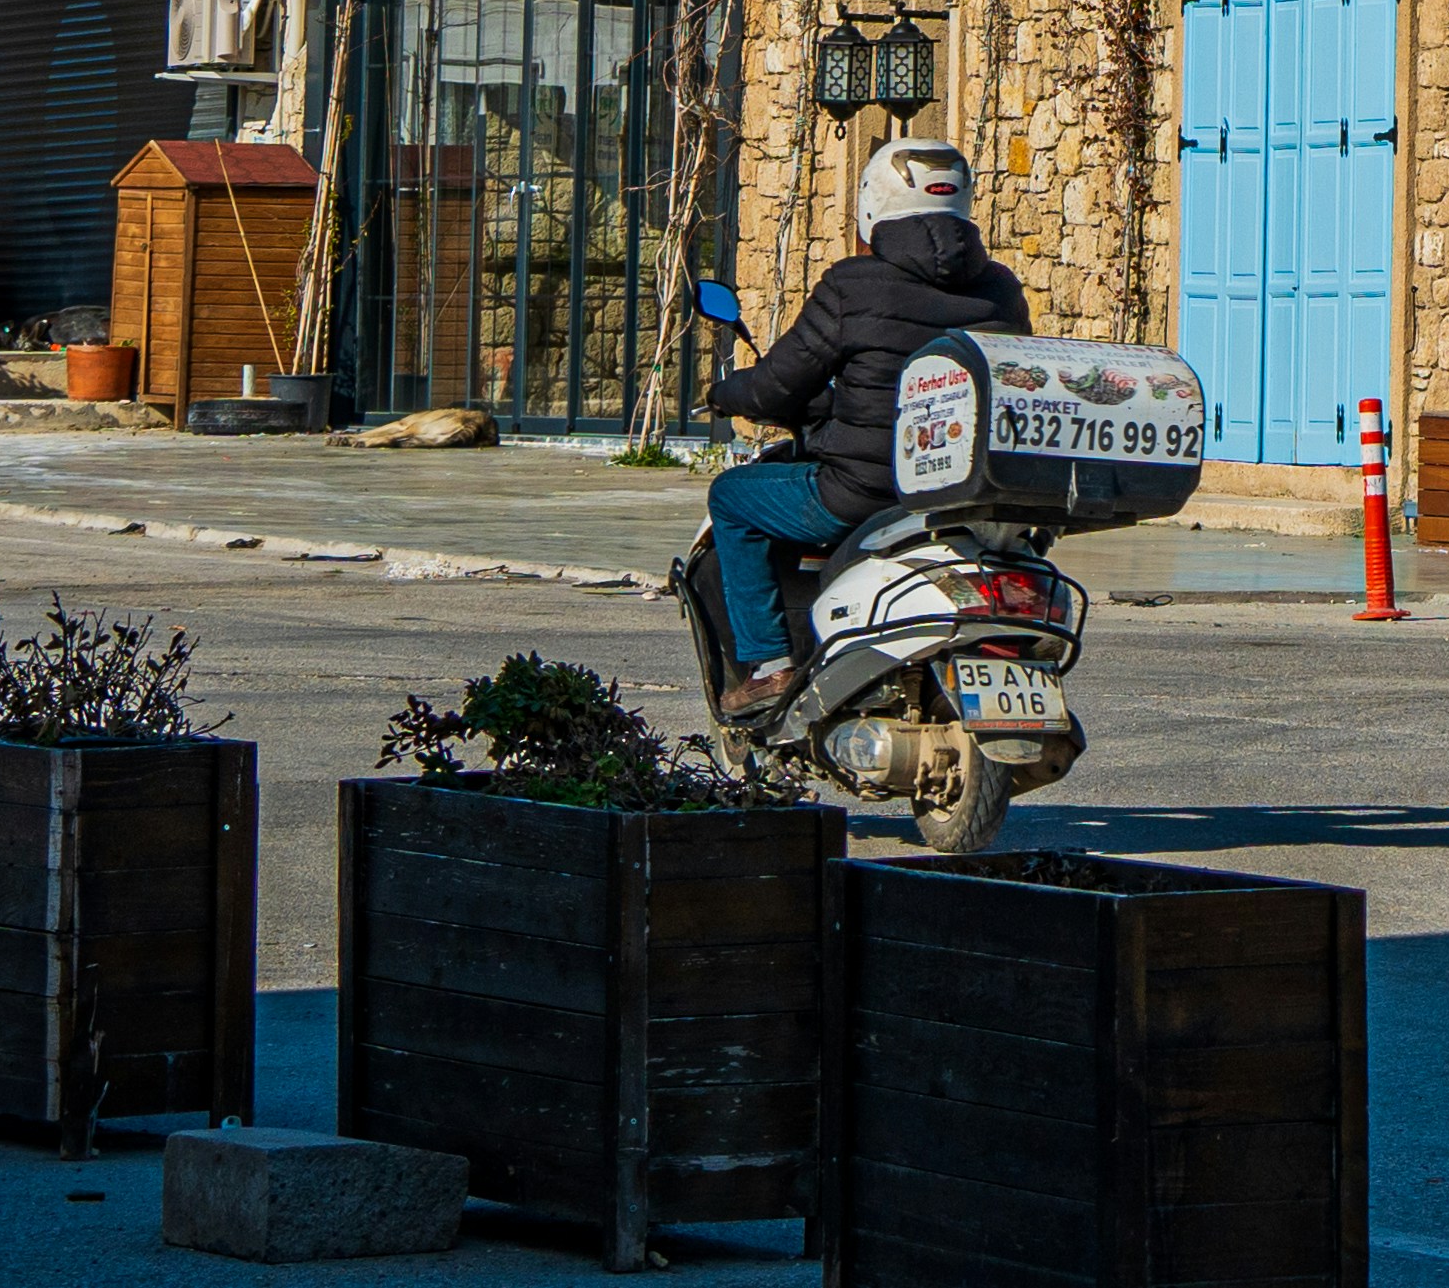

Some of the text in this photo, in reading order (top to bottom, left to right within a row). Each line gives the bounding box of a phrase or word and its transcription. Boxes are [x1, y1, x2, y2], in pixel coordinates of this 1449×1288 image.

[917, 368, 969, 393] Ferhat Usta
[995, 396, 1082, 415] ALO PAKET
[996, 410, 1199, 458] 0232 716 99 92
[959, 664, 1059, 689] 35 AYN
[967, 709, 979, 717] TR
[997, 691, 1046, 715] 016
